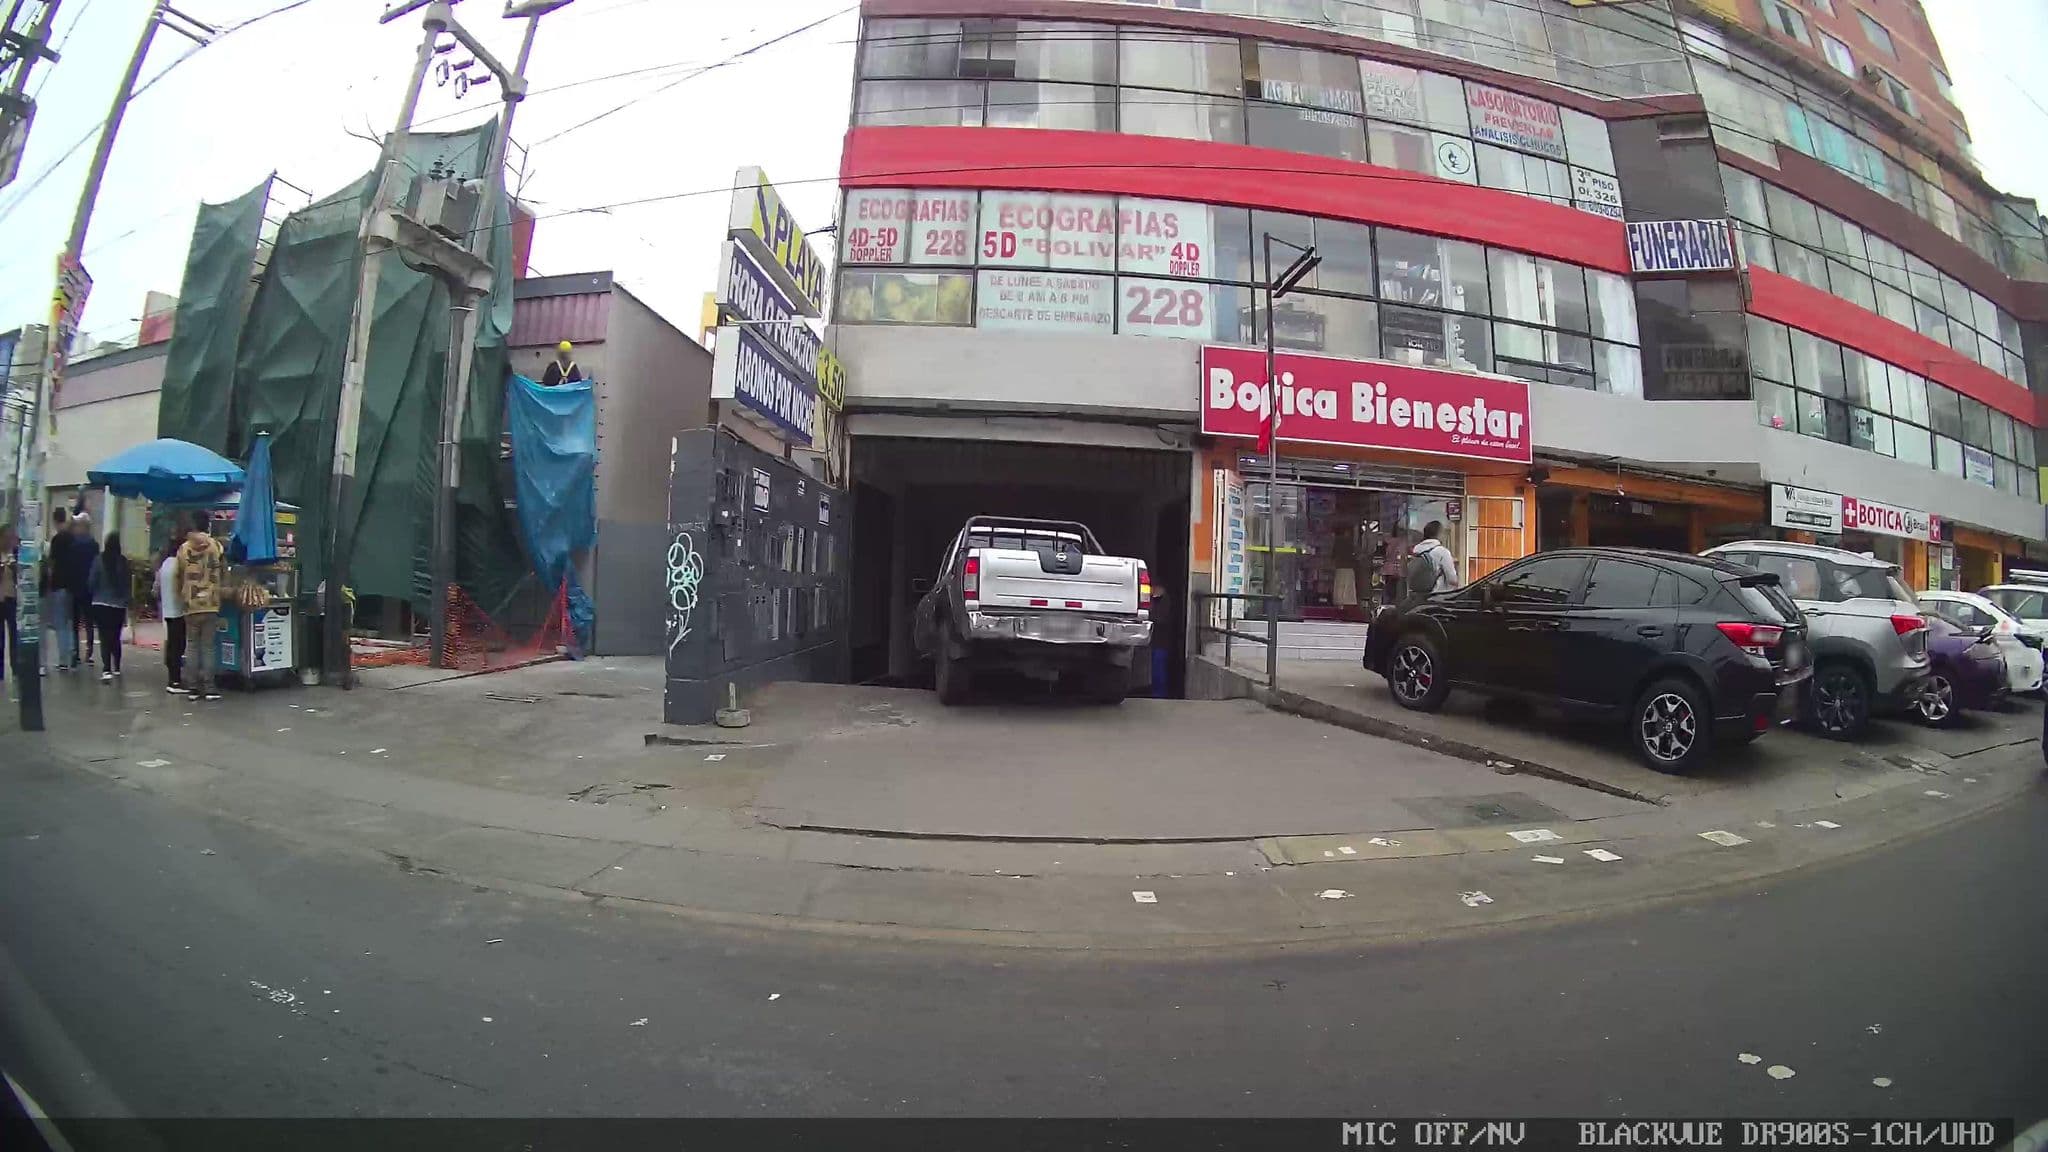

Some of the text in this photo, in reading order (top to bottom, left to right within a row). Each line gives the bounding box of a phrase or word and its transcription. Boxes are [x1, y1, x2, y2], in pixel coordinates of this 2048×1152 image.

[1468, 85, 1558, 126] LABORATORIO
[1474, 125, 1518, 145] ANALISIS
[1592, 178, 1615, 192] PISO
[858, 198, 970, 223] ECOGRAFIAS
[998, 202, 1180, 239] ECOGRAFIAS
[772, 201, 823, 313] PLAYA
[848, 227, 967, 256] 4D-5D 228
[849, 246, 892, 262] DOPPLER
[983, 231, 1200, 262] 5D "BOLIVAR" 4D
[1628, 220, 1735, 271] FUNERARIA
[1169, 261, 1200, 276] DOPPLER
[729, 258, 765, 327] HORA
[765, 297, 775, 337] O
[1125, 285, 1204, 328] 228
[736, 341, 776, 410] ABONOS
[775, 372, 793, 422] POR
[1351, 381, 1524, 439] Bienestar
[1859, 504, 1903, 532] BOTICA
